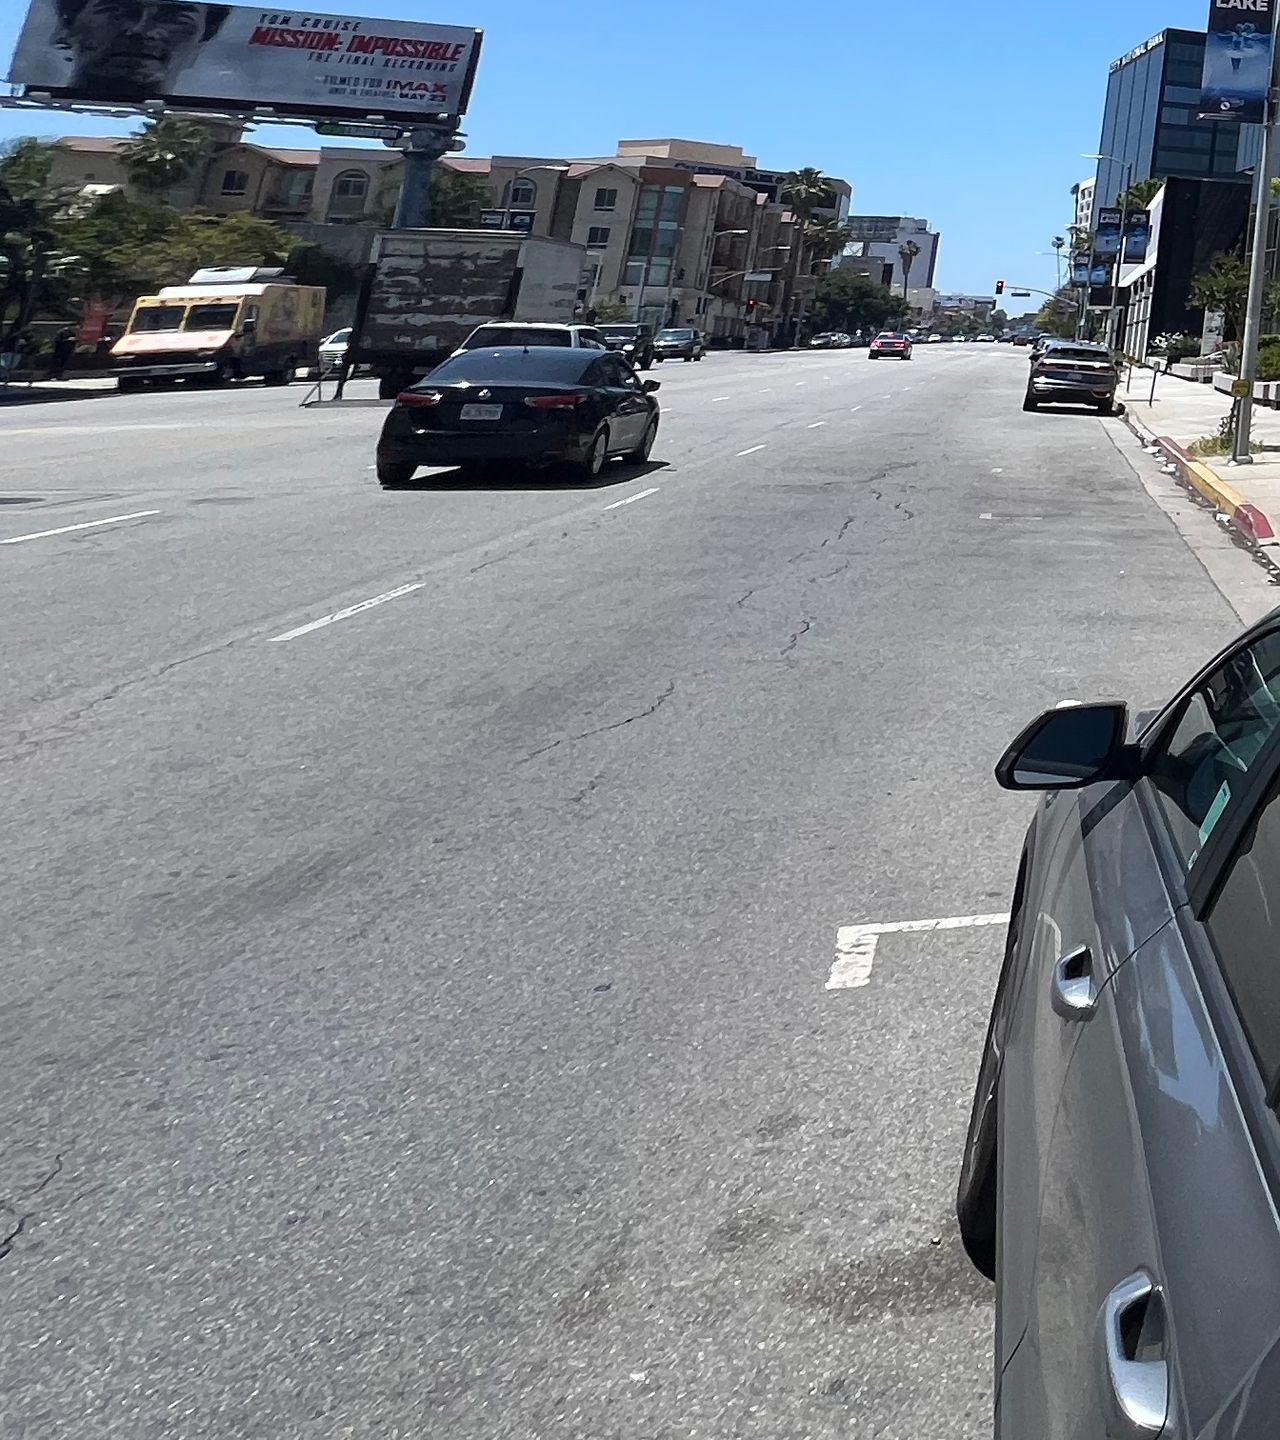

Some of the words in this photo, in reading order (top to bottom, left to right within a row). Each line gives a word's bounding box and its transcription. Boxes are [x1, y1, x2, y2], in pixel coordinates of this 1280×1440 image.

[260, 13, 292, 26] TOM
[301, 17, 362, 32] CRUISE
[346, 35, 466, 62] IMPOSSIBLE
[338, 53, 375, 67] FINAL
[386, 79, 447, 93] IMAX
